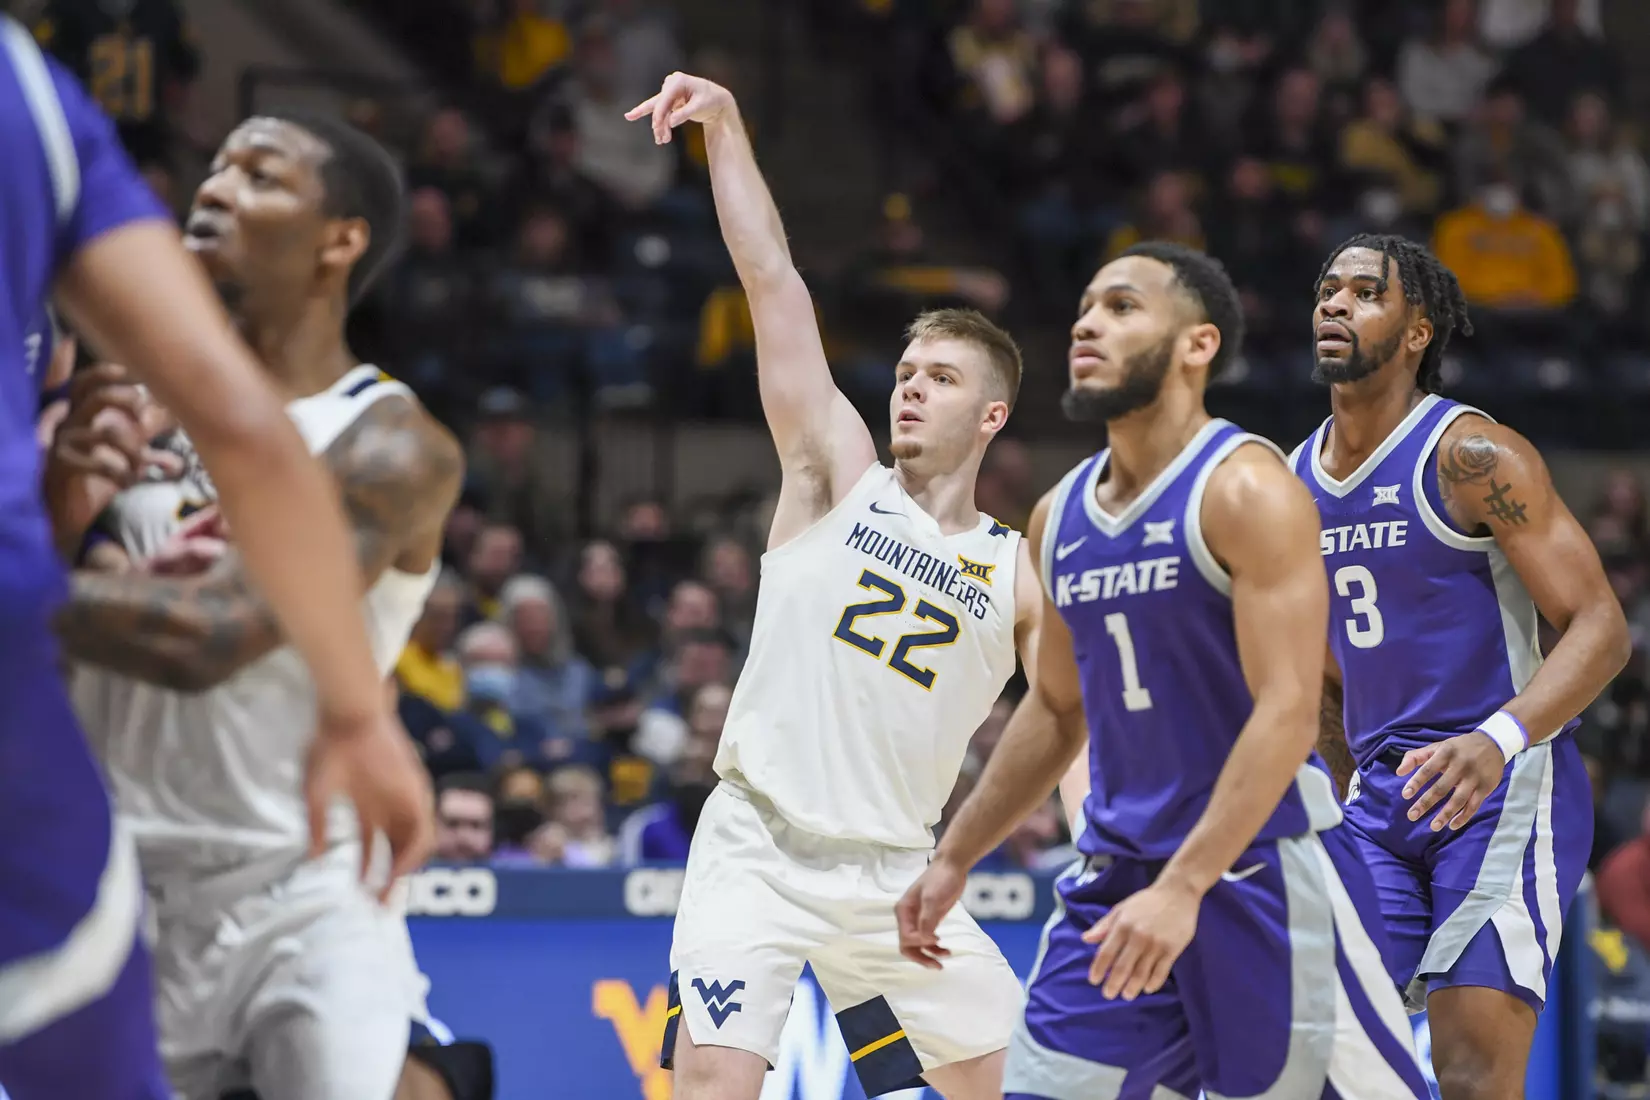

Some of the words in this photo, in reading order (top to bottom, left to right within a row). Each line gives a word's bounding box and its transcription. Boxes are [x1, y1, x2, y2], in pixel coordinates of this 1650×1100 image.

[845, 522, 990, 620] MOUNTAINEERS
[1056, 556, 1181, 608] K-STATE
[1334, 565, 1385, 649] 3
[832, 568, 962, 692] 22
[1105, 612, 1153, 712] 1
